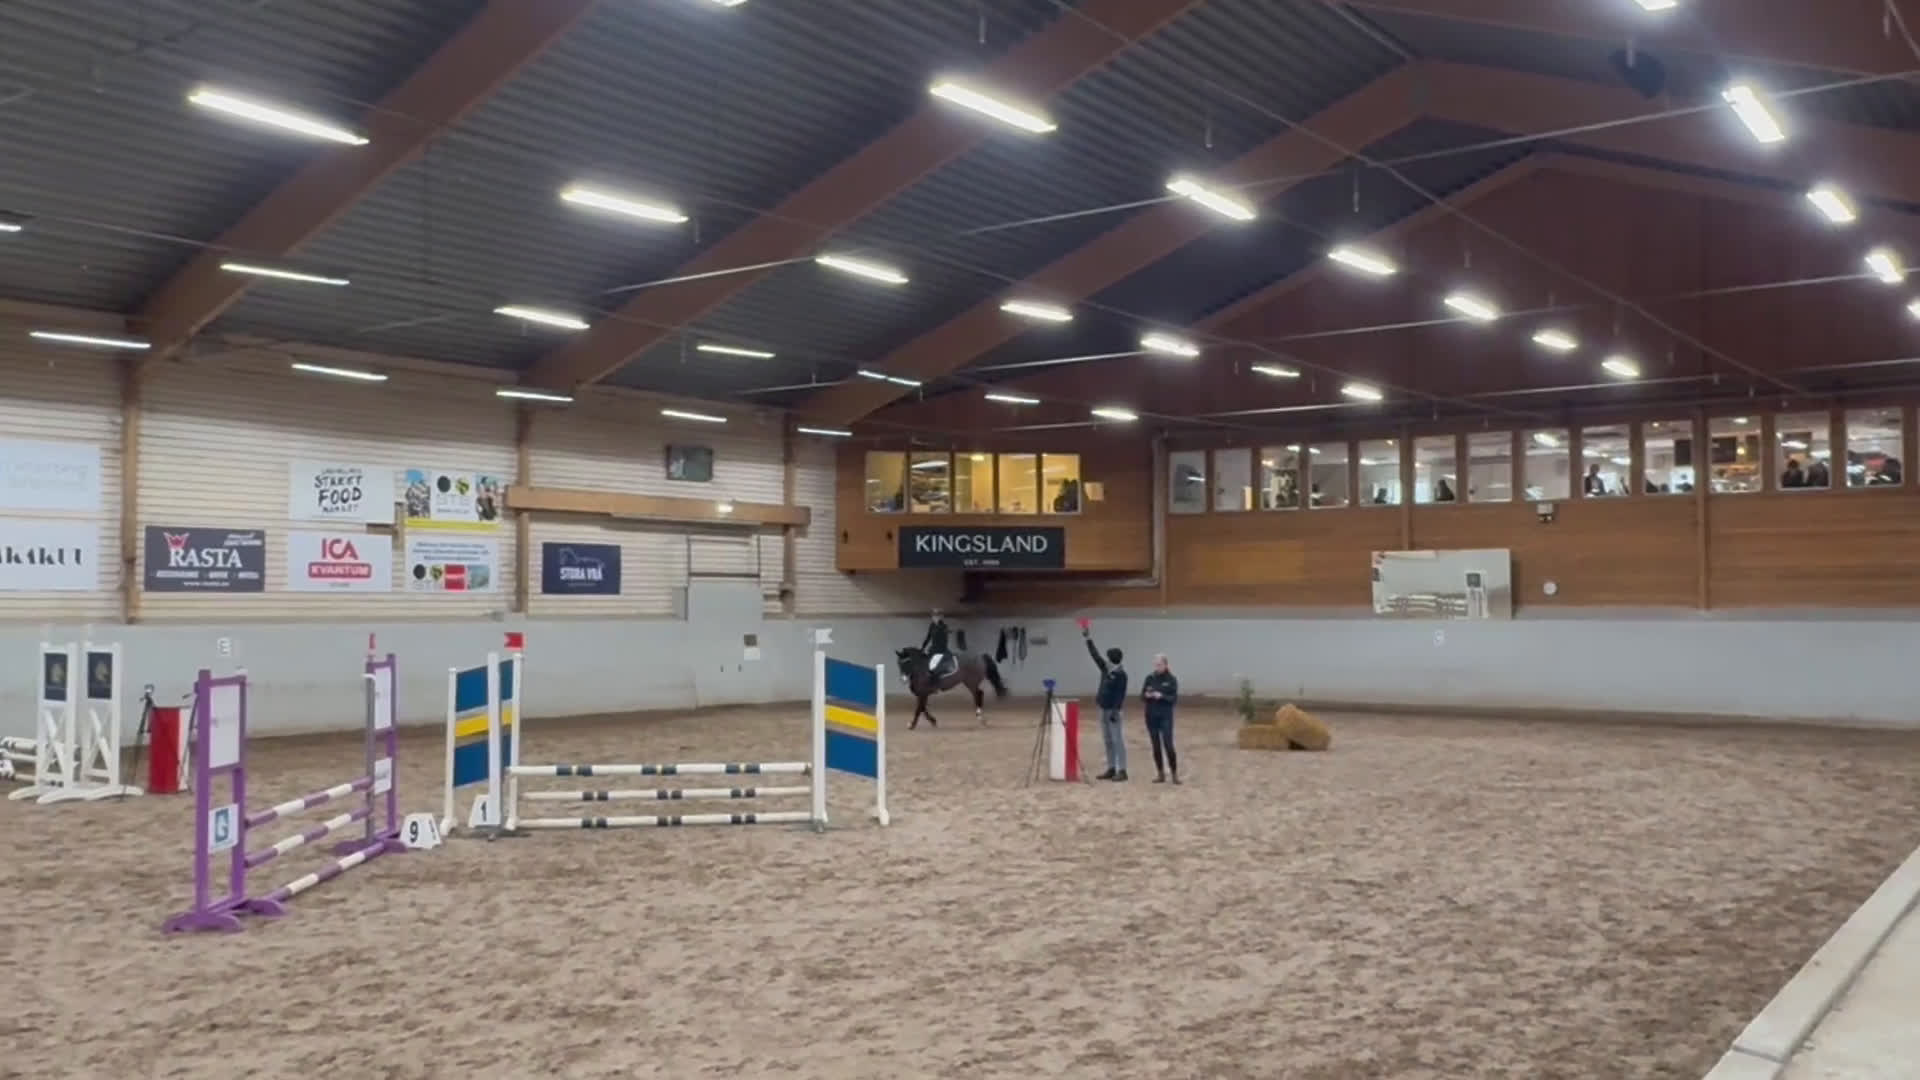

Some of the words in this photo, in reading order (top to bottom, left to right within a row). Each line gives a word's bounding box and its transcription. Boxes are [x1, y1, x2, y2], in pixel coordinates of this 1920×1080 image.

[318, 486, 362, 507] FOOD
[321, 538, 358, 560] ICA
[915, 534, 1049, 553] KINGSLAND
[168, 548, 243, 568] RASTA
[409, 821, 418, 843] 9
